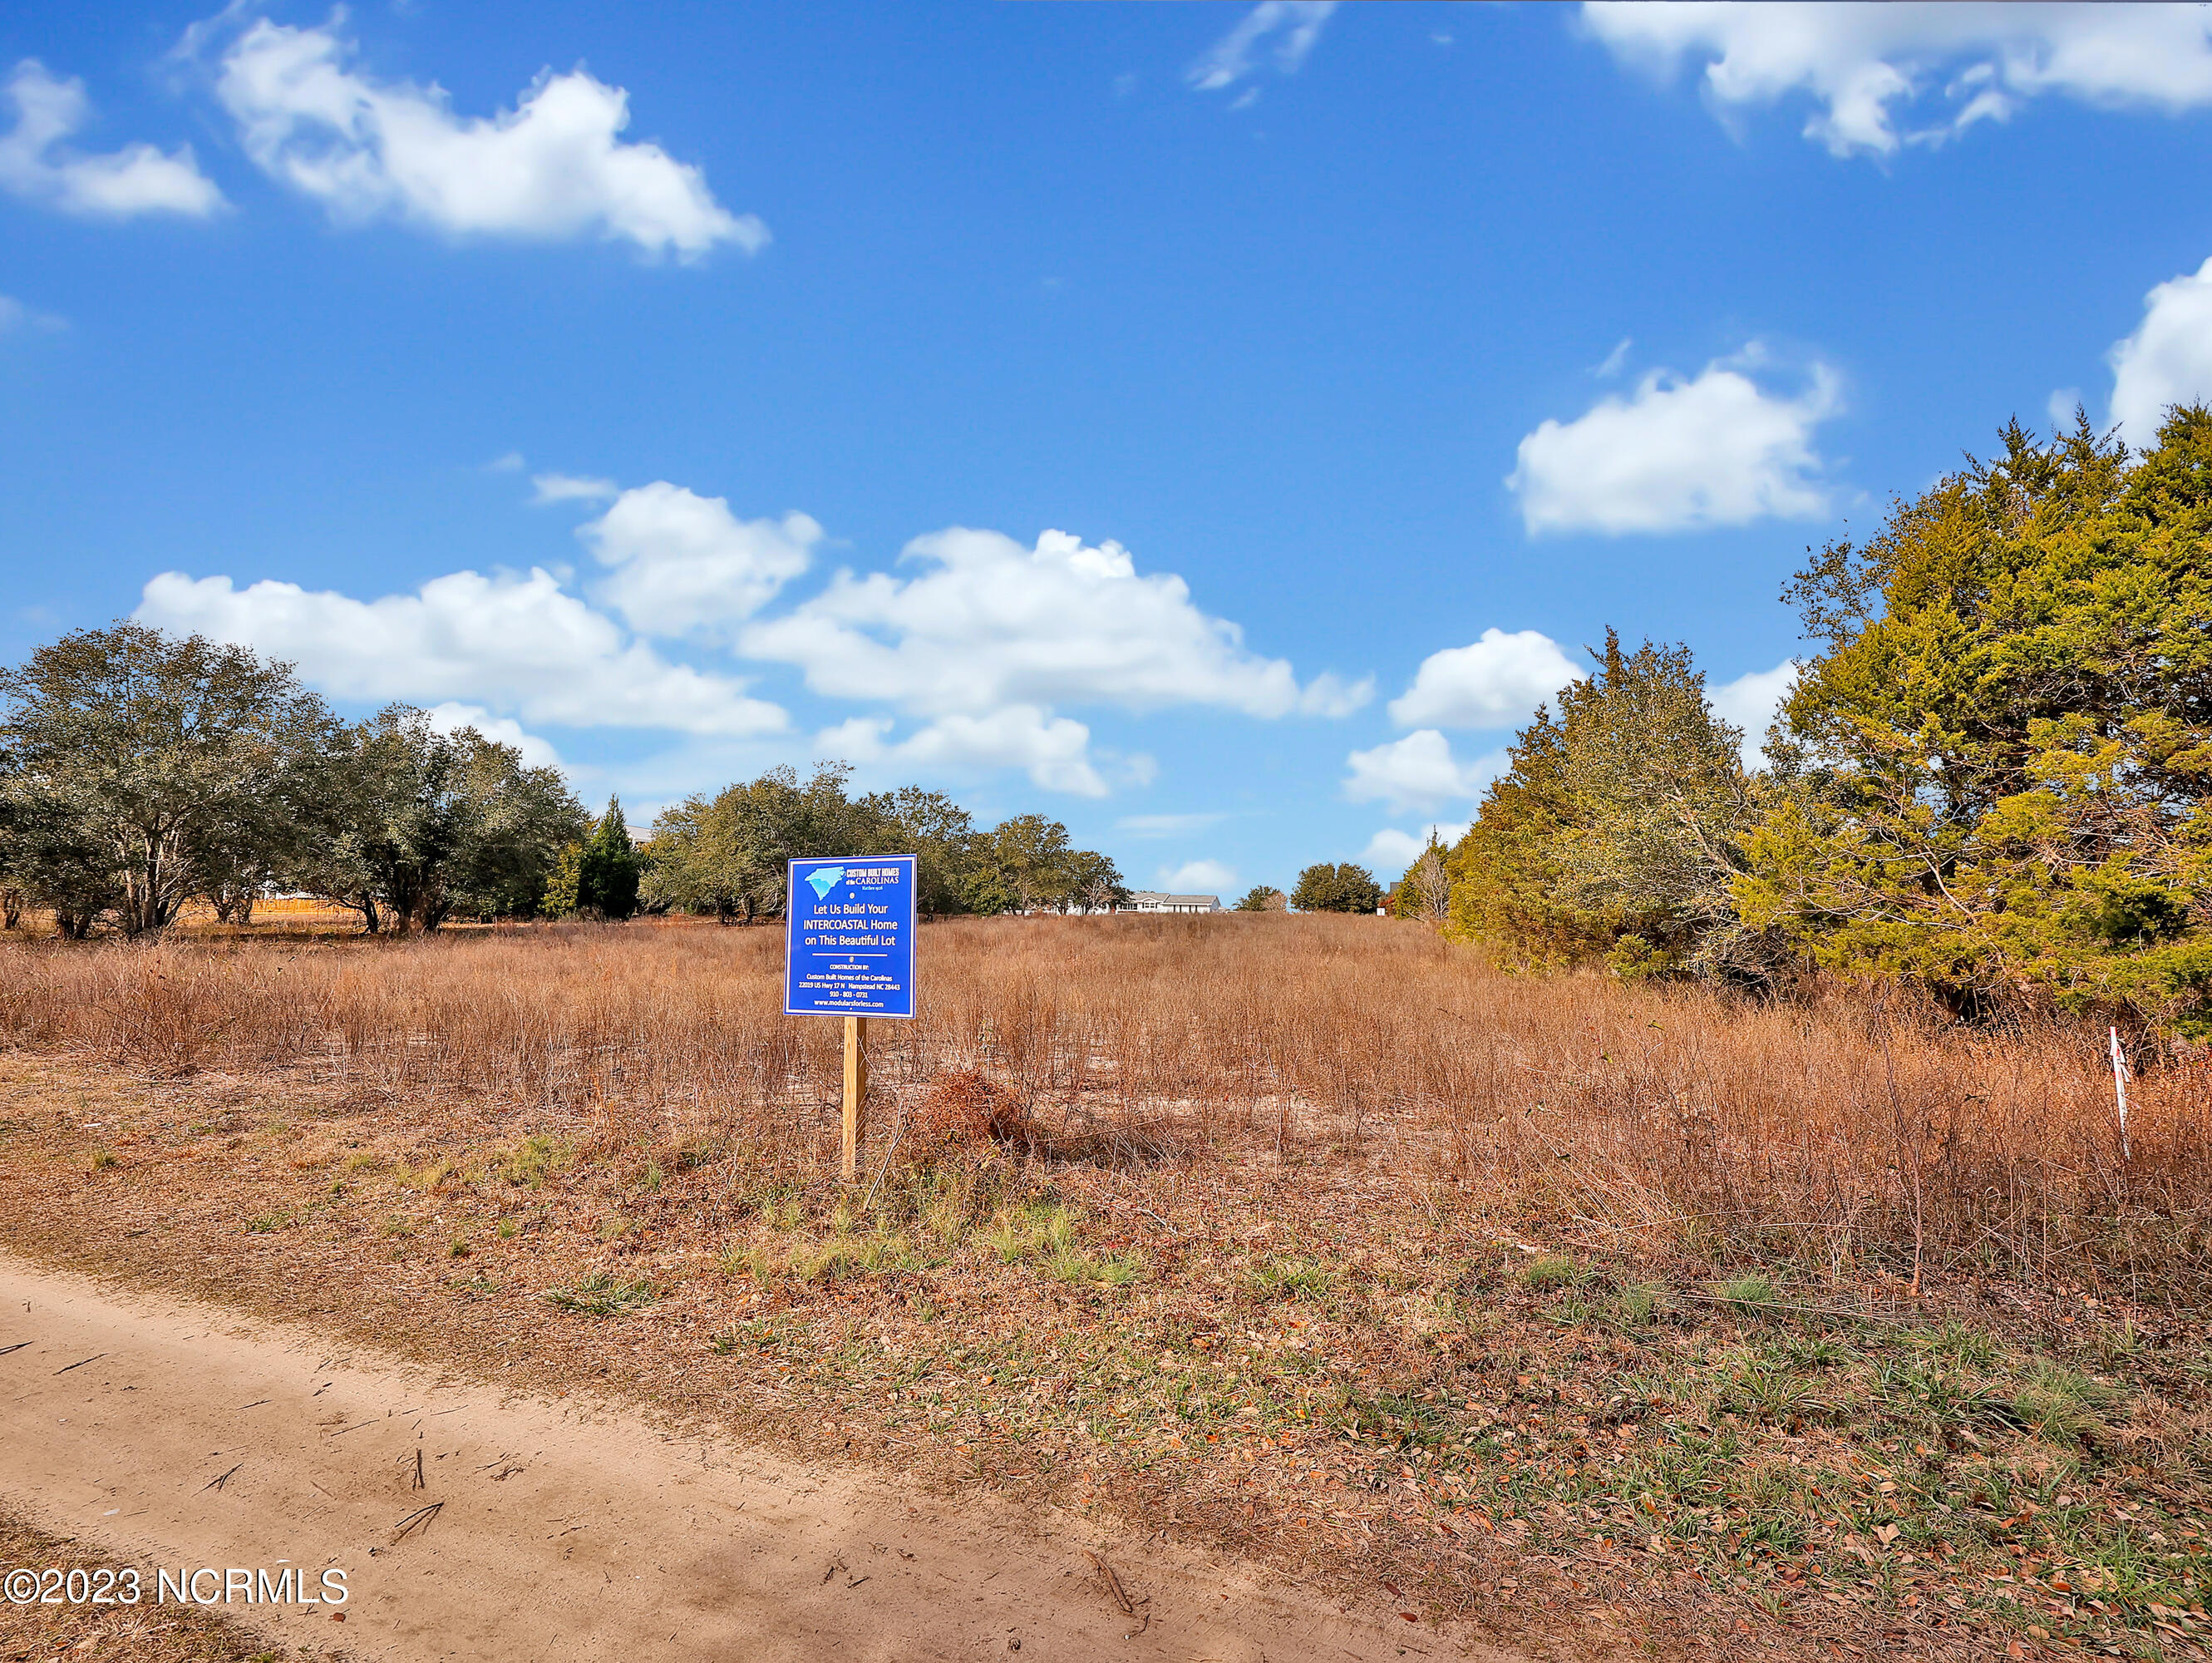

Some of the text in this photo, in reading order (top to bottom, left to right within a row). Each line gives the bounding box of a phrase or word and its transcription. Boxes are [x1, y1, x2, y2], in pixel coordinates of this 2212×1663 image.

[867, 868, 881, 877] BUILT
[882, 867, 899, 876] HOMES
[814, 903, 889, 914] Let Us Build Your
[803, 919, 899, 930] INTERCOASTAL Home
[805, 934, 896, 946] on This Beautiful Lot
[814, 999, 884, 1008] www.modularsforless.com
